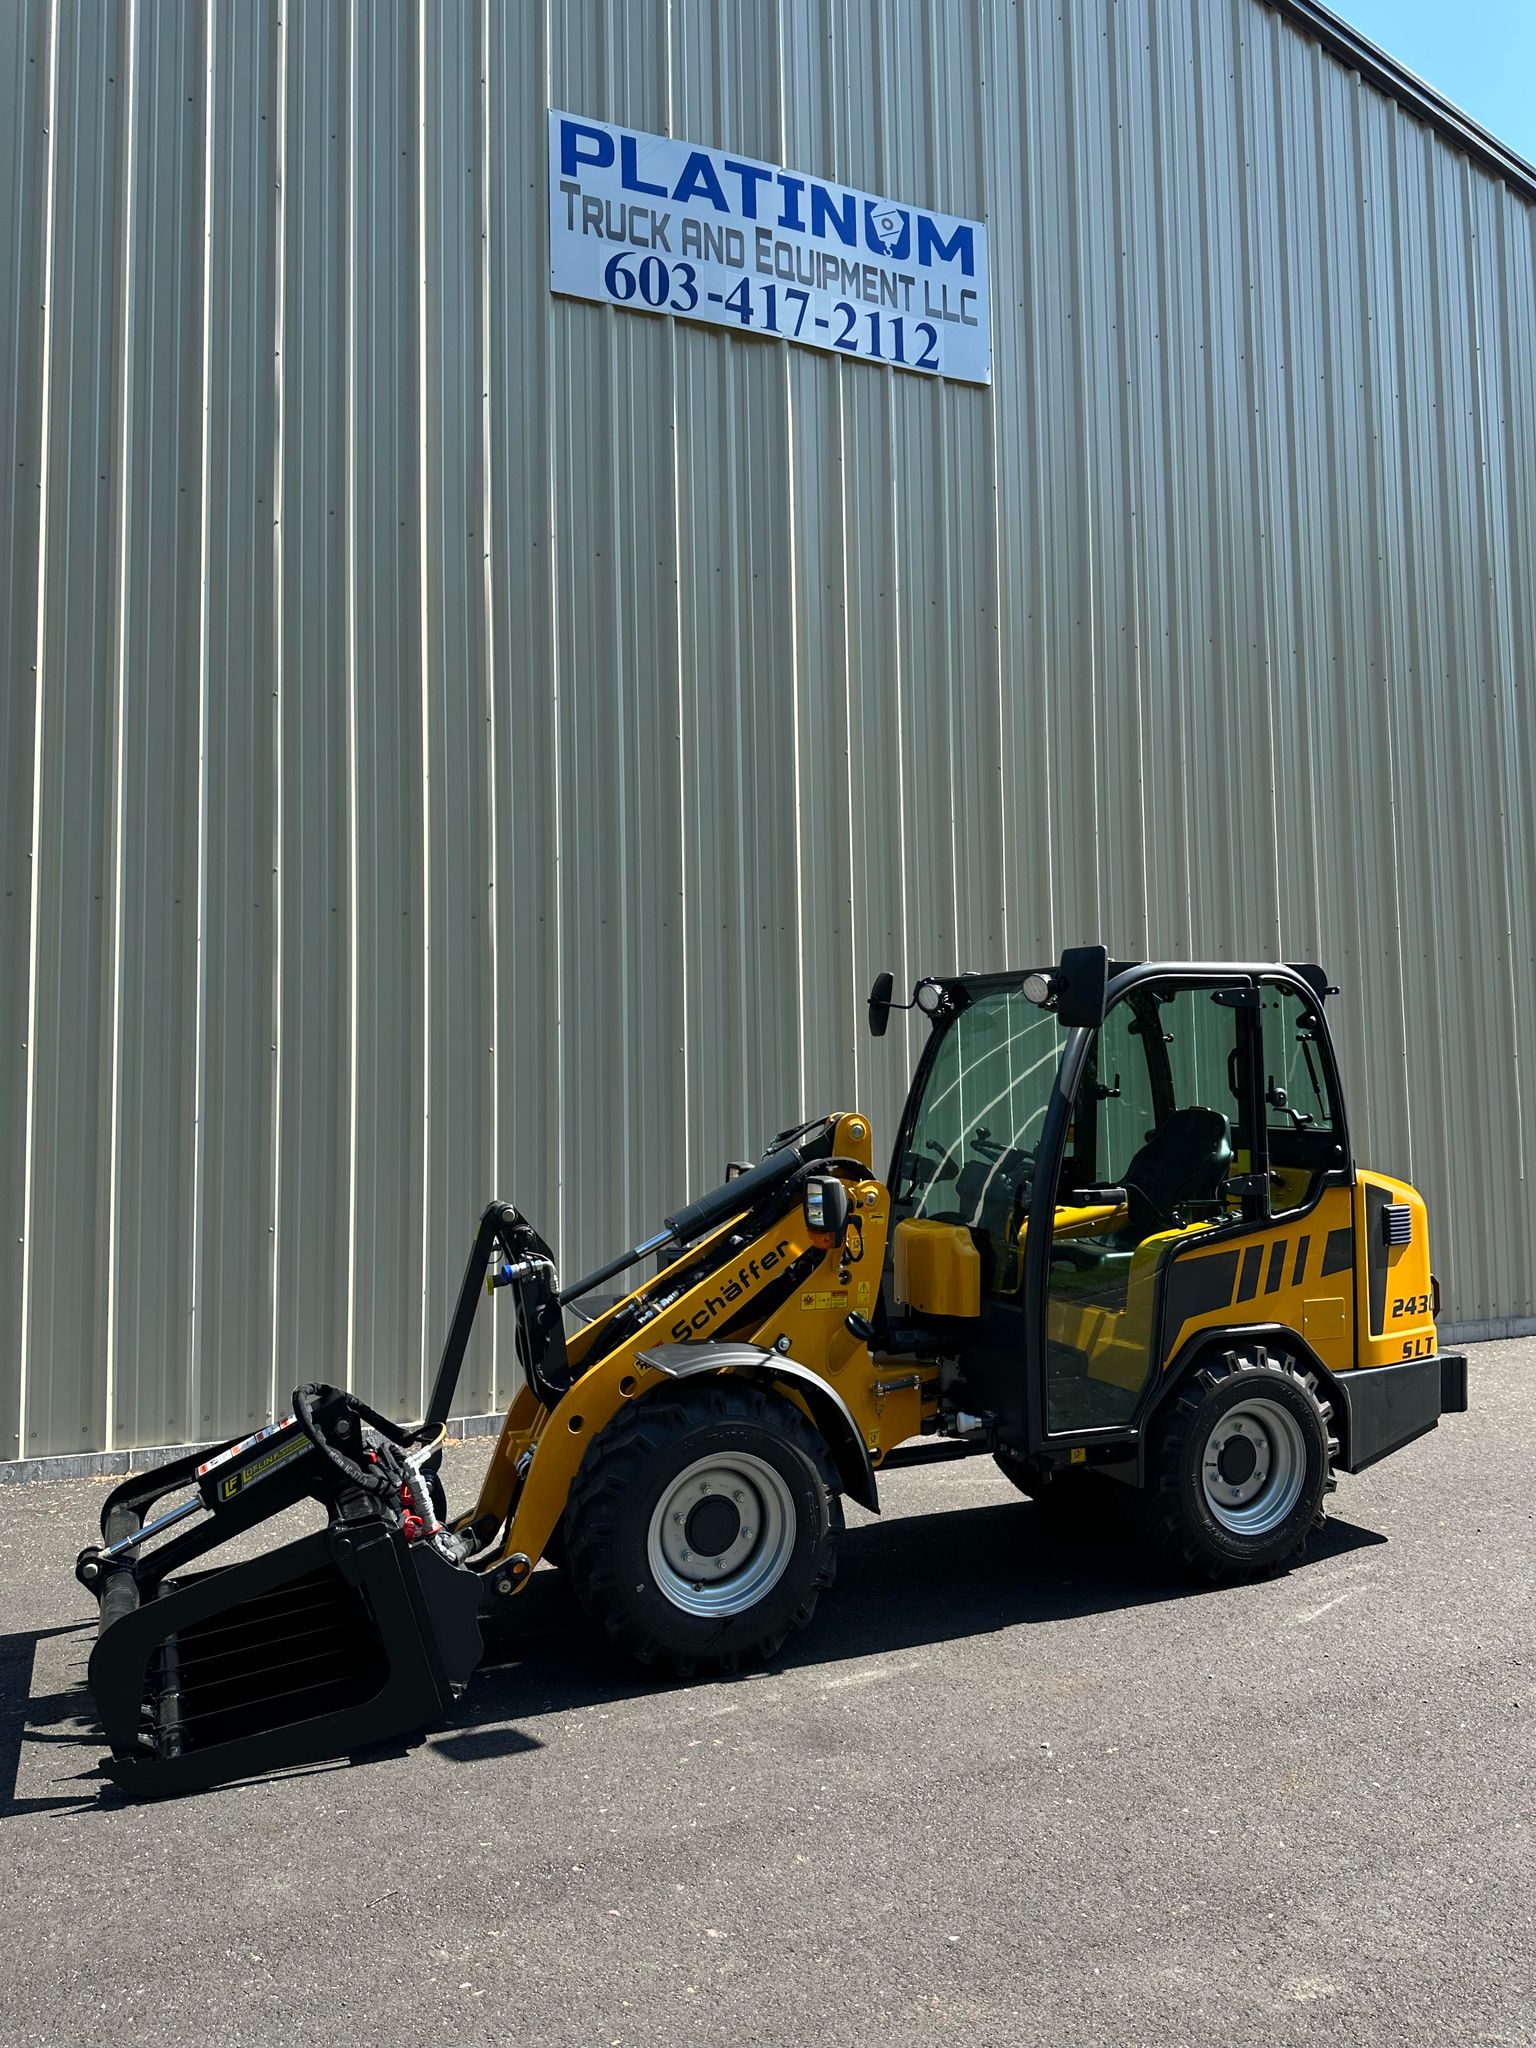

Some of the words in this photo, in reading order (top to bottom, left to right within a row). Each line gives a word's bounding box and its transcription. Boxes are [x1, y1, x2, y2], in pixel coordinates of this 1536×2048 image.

[559, 179, 672, 253] TRUCK
[681, 217, 746, 269] AND
[755, 226, 915, 312] EQUIPMENT
[924, 279, 978, 327] LLC
[560, 119, 975, 278] PLATINUM
[603, 251, 940, 371] 603-417-2112
[671, 1240, 789, 1343] Schäffer
[1402, 1336, 1434, 1359] SLT
[224, 1475, 238, 1498] LF
